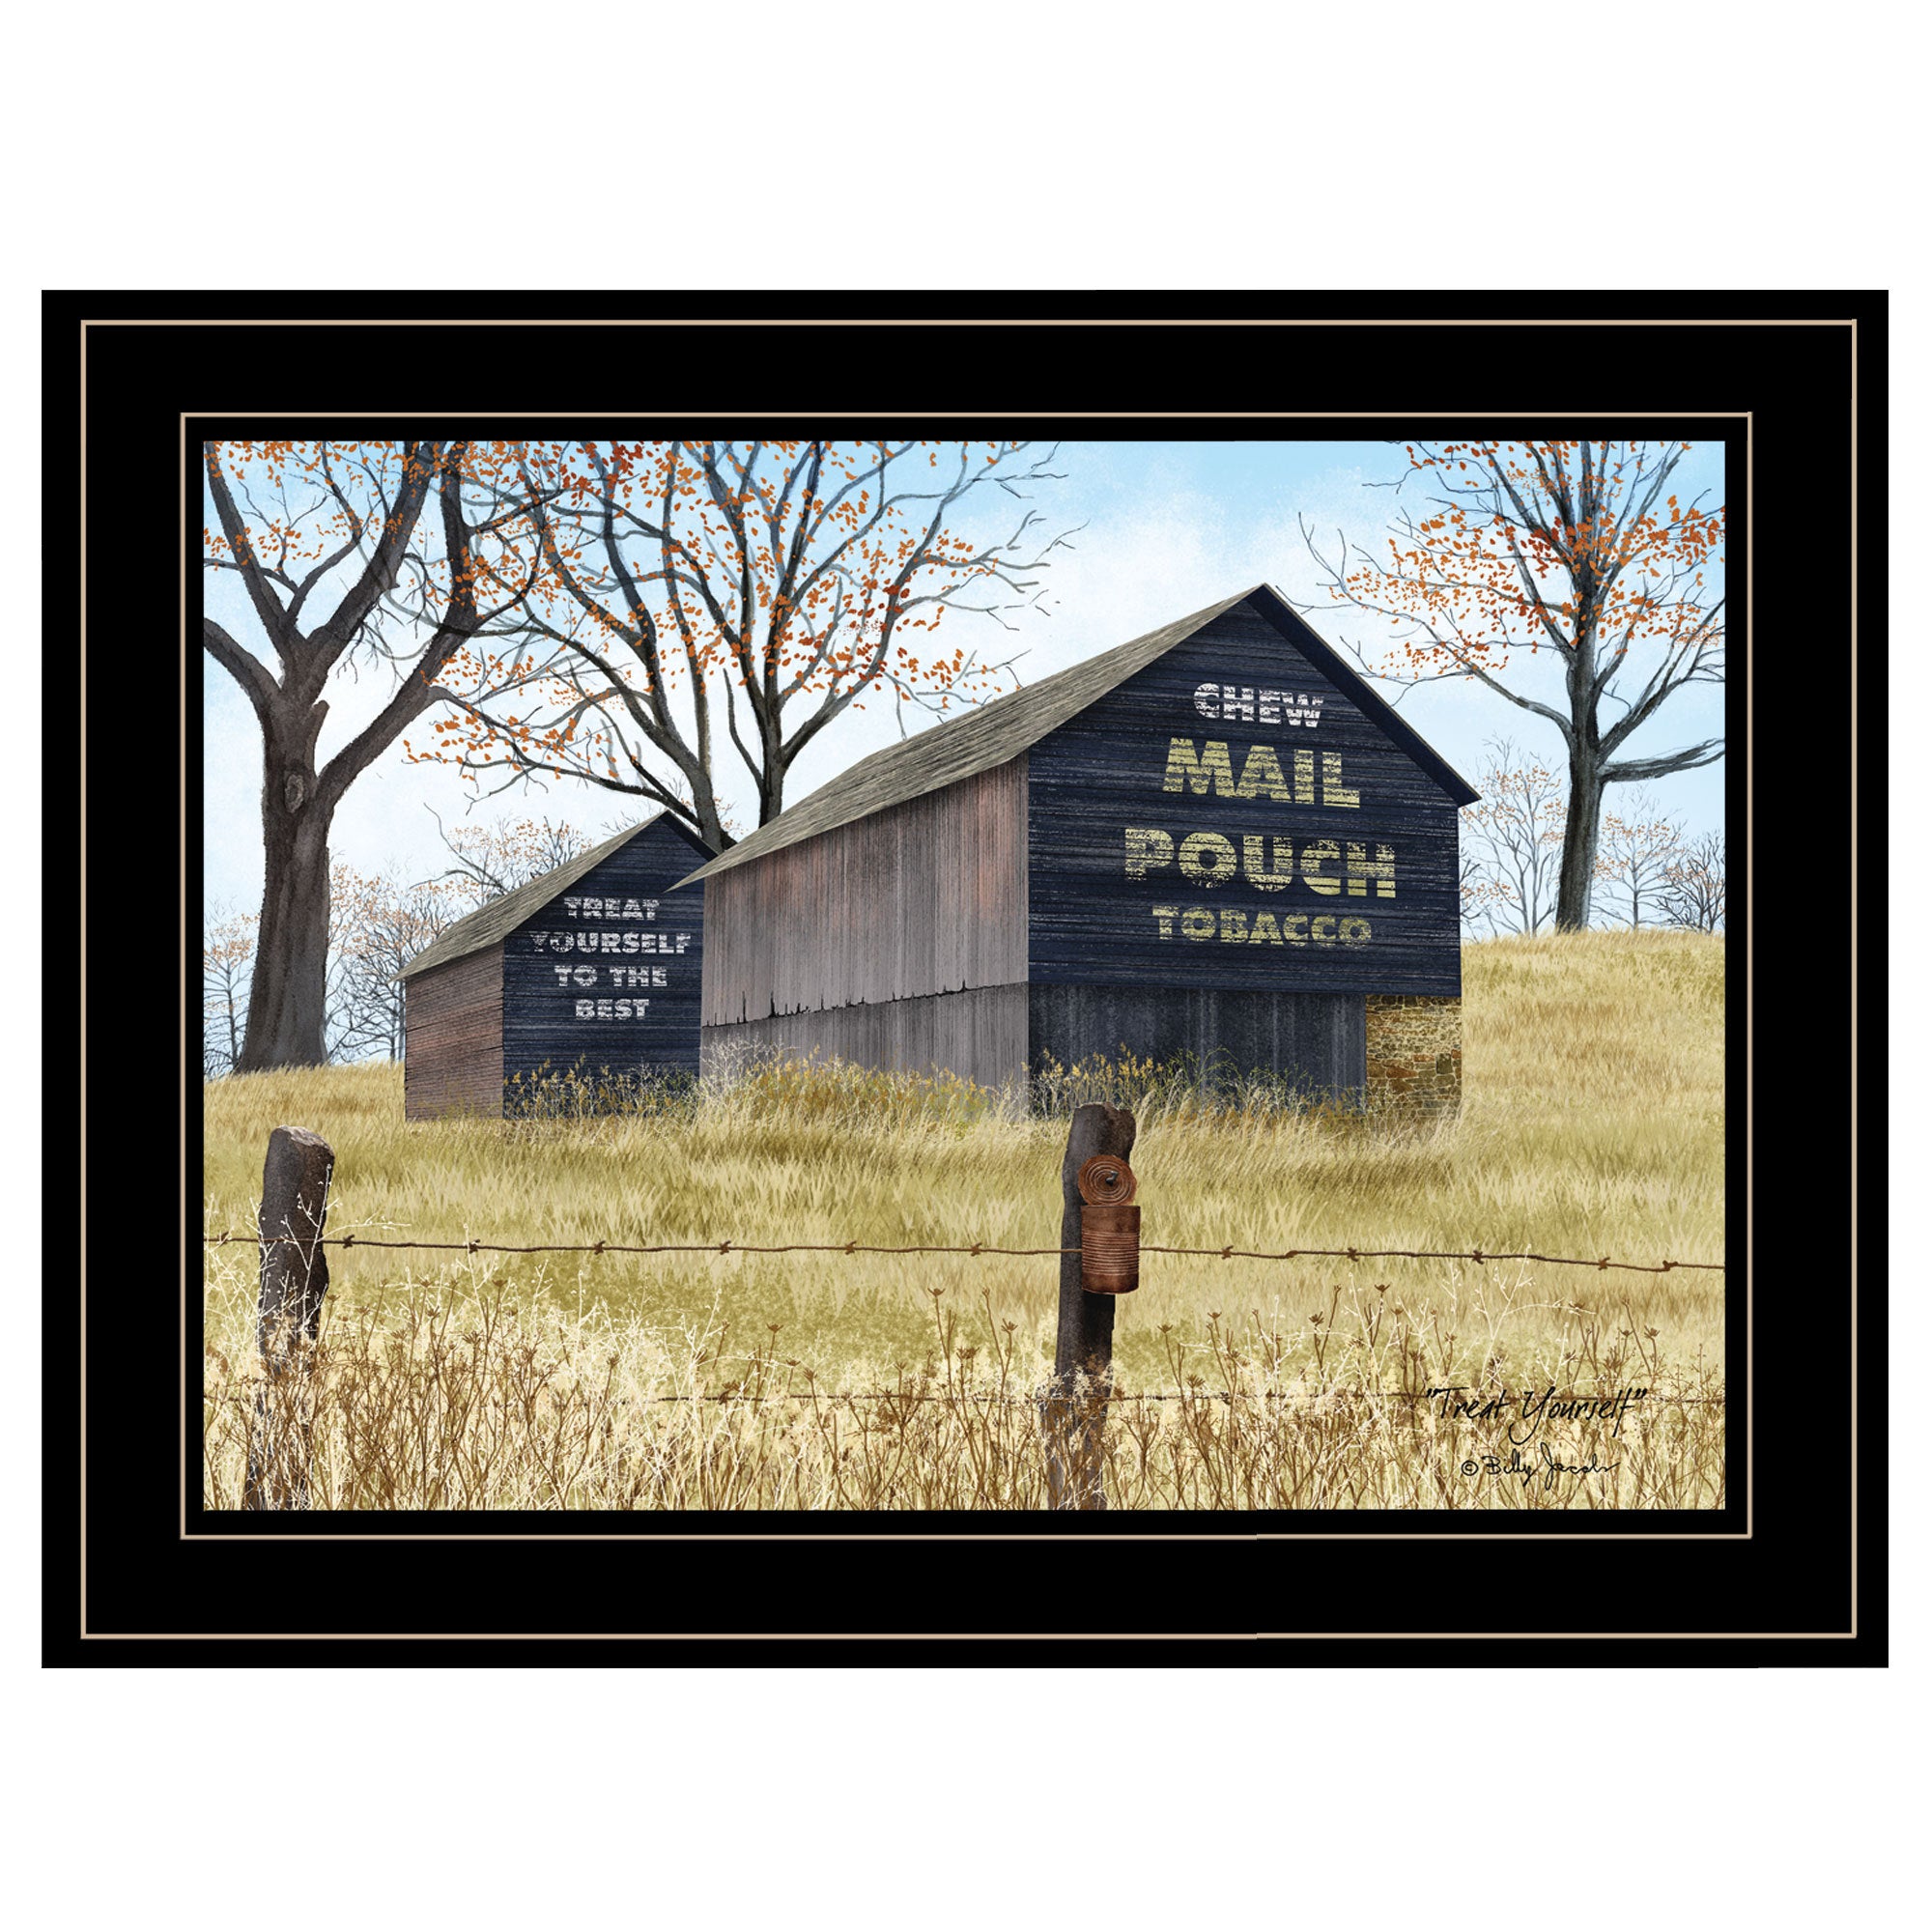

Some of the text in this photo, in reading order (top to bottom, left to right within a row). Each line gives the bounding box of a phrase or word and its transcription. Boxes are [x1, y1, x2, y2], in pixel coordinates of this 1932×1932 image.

[1193, 682, 1324, 727] CHEW
[1162, 737, 1360, 809] MAIL
[1124, 828, 1397, 898] POUCH
[563, 896, 660, 921] TREAT
[529, 930, 692, 954] YOURSELF
[1152, 905, 1373, 949] TOBACCO
[554, 965, 668, 987] TO THE
[575, 999, 649, 1020] BEST
